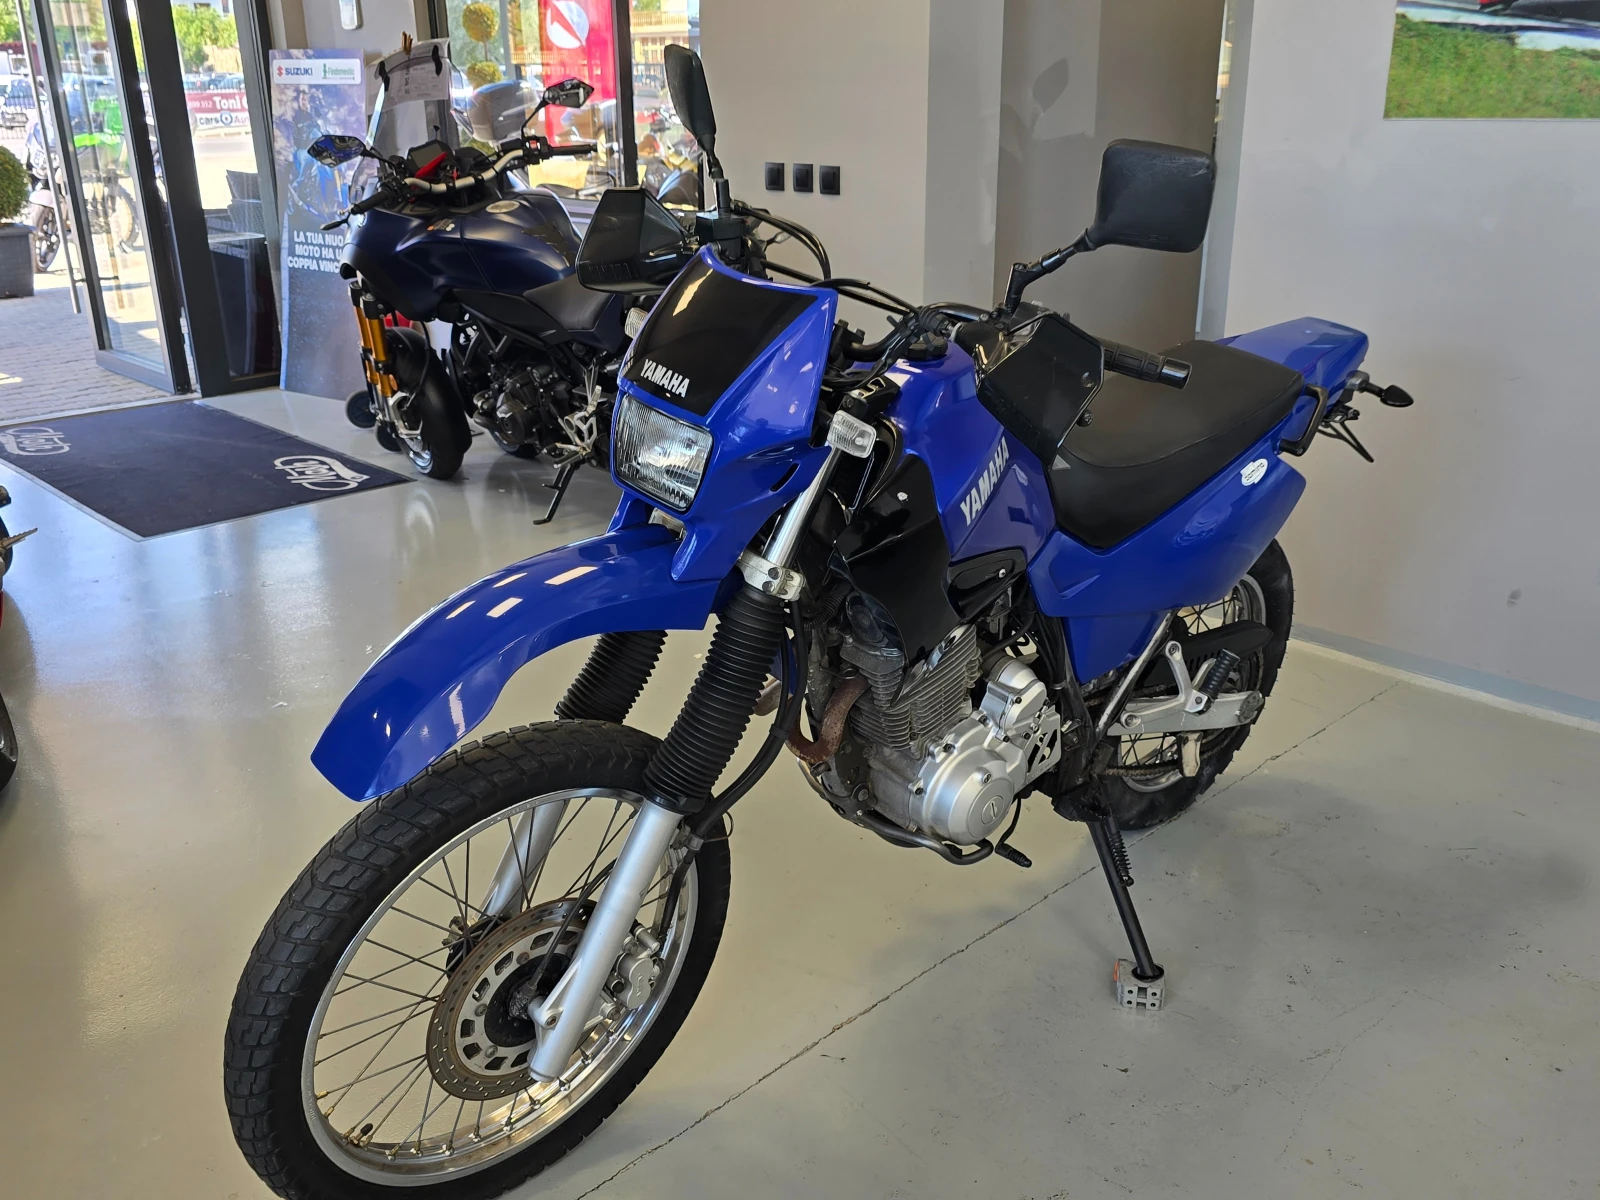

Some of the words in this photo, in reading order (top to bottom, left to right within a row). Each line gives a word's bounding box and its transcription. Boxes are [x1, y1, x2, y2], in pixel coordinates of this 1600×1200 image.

[285, 67, 313, 76] SUZUKI
[213, 95, 241, 110] Toni
[293, 230, 305, 243] LA
[306, 231, 324, 245] TUA
[325, 233, 343, 247] NUO
[295, 244, 320, 257] MOTO
[322, 247, 334, 259] HA
[287, 256, 318, 271] COPPIA
[640, 358, 690, 399] YAMAHA
[959, 435, 1010, 527] YAMAHA
